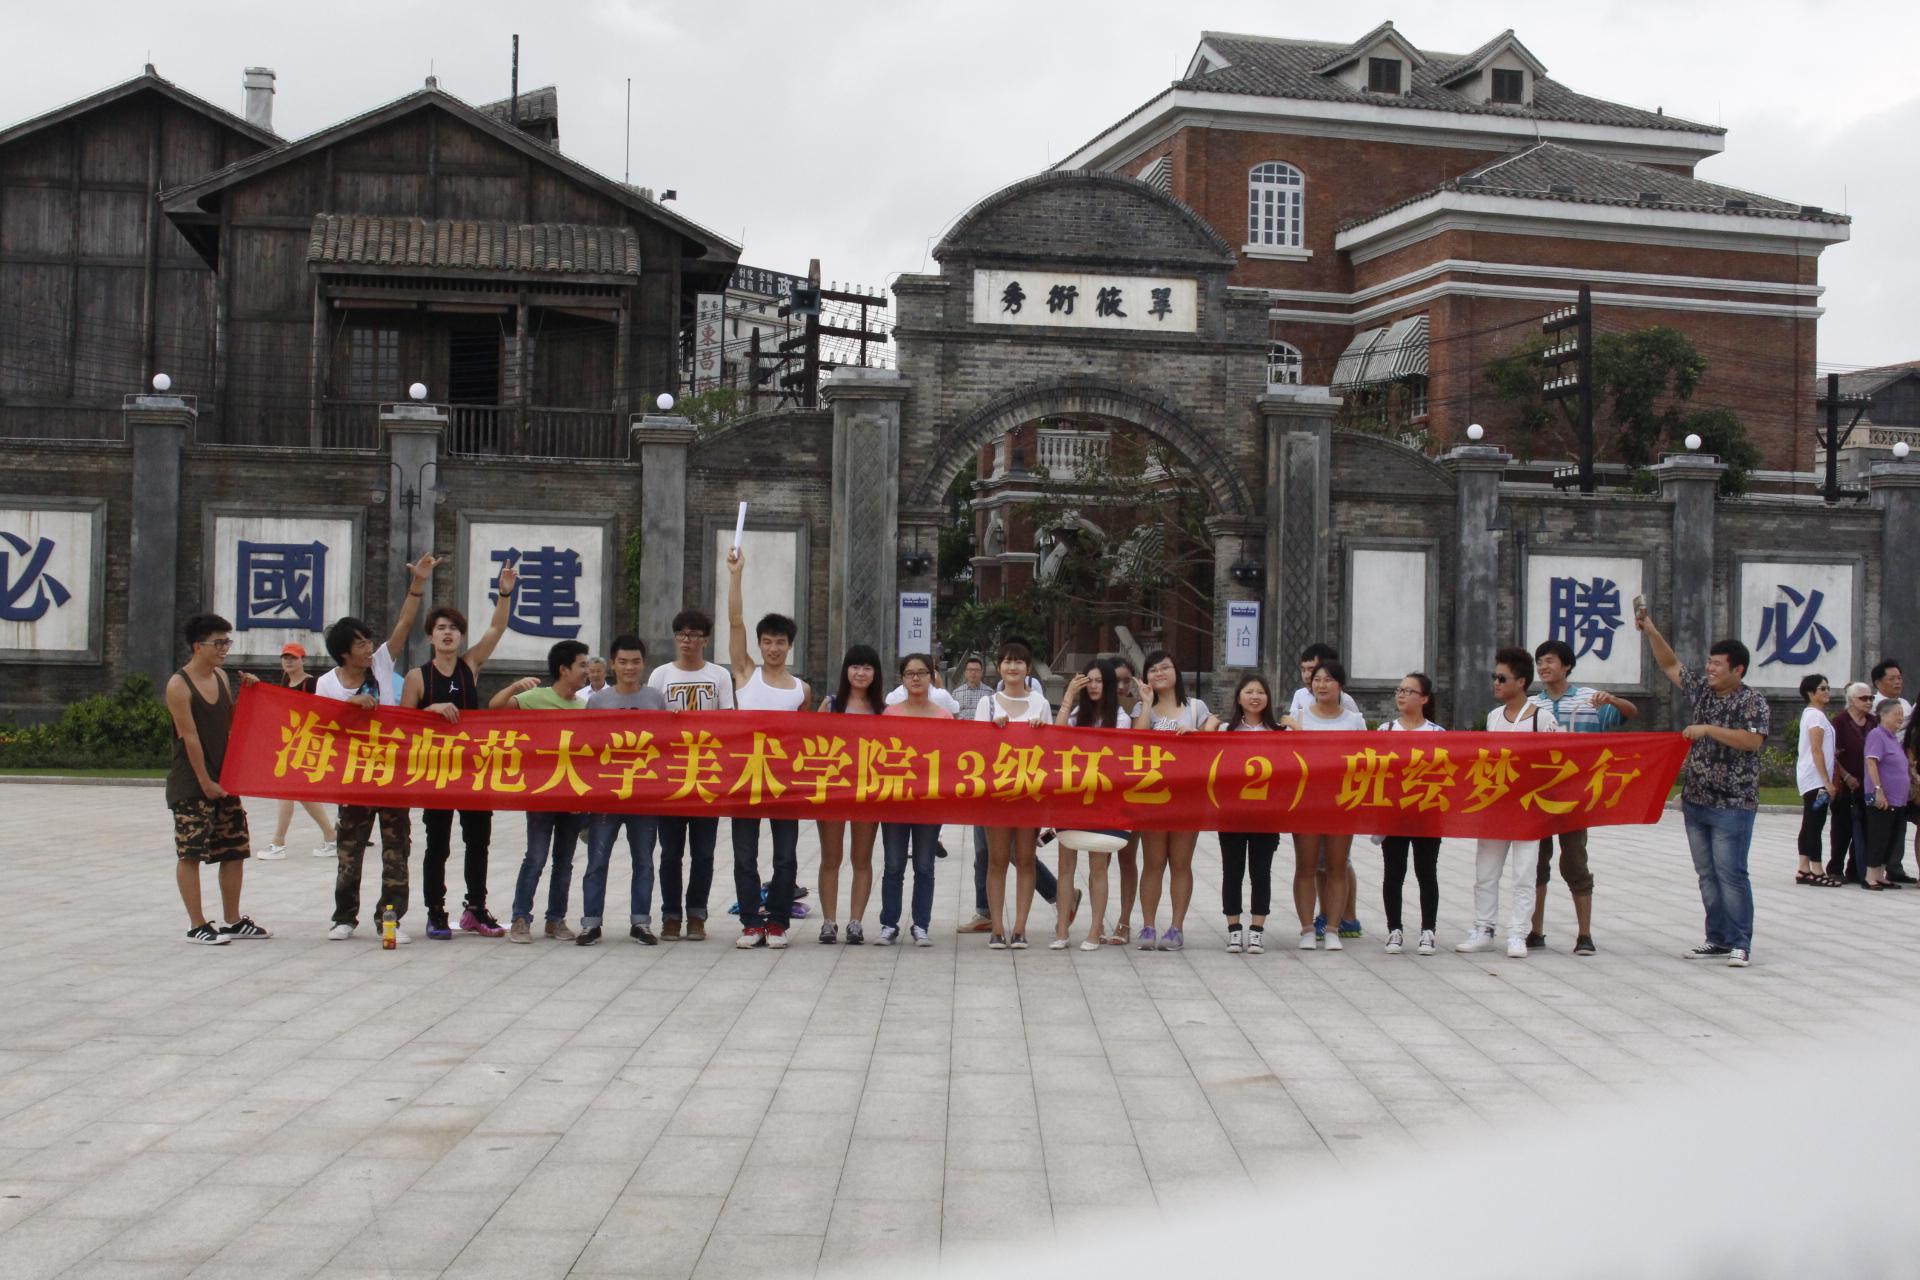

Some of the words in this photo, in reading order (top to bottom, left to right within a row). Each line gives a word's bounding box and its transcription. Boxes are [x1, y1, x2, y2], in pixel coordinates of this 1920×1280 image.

[0, 531, 72, 621] 必
[236, 540, 328, 632] 國
[489, 546, 581, 638] 建
[912, 616, 923, 639] 出口
[1241, 624, 1251, 647] 入口
[1550, 577, 1624, 661] 勝
[1755, 584, 1837, 667] 必
[667, 681, 716, 710] T
